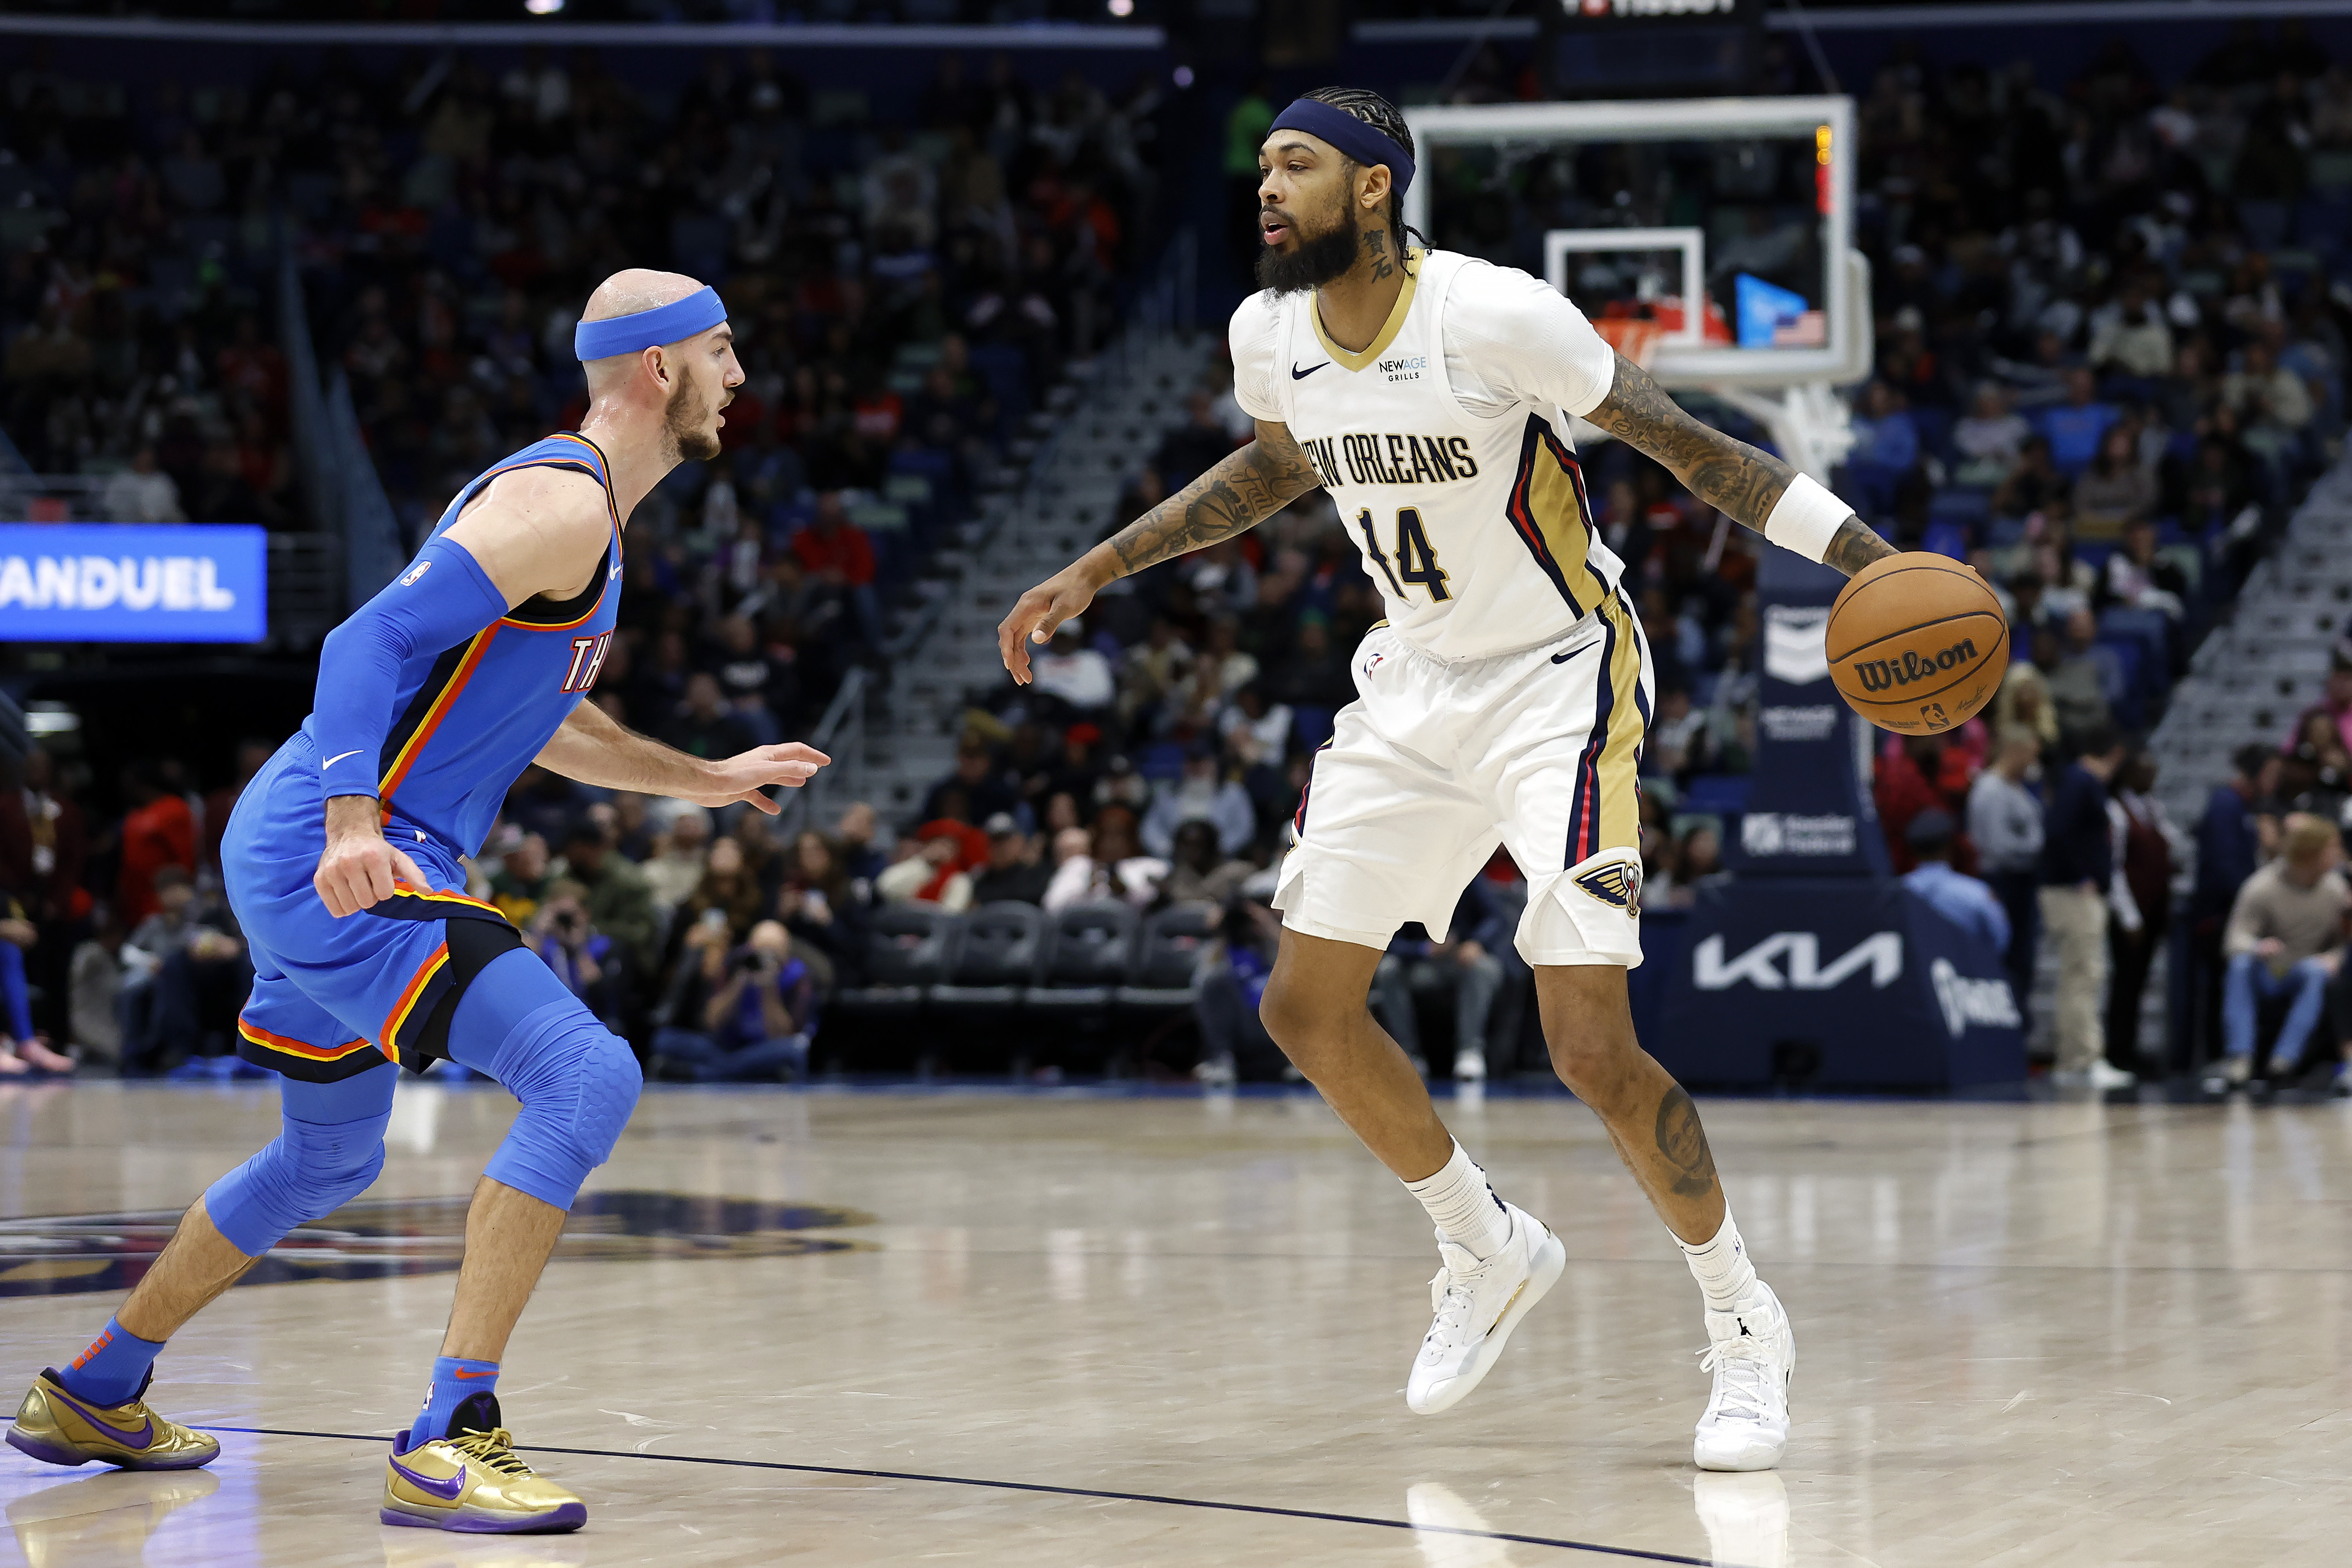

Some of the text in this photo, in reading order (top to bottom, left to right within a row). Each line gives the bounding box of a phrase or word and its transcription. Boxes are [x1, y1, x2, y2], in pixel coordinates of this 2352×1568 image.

[1379, 357, 1426, 373] NEWAGE
[1388, 372, 1419, 381] GRILLS
[1342, 433, 1479, 485] ORLEANS
[1356, 506, 1453, 603] 14
[0, 556, 235, 611] ANDUEL
[1853, 638, 1979, 692] Wilson
[1693, 931, 1904, 991] KIA
